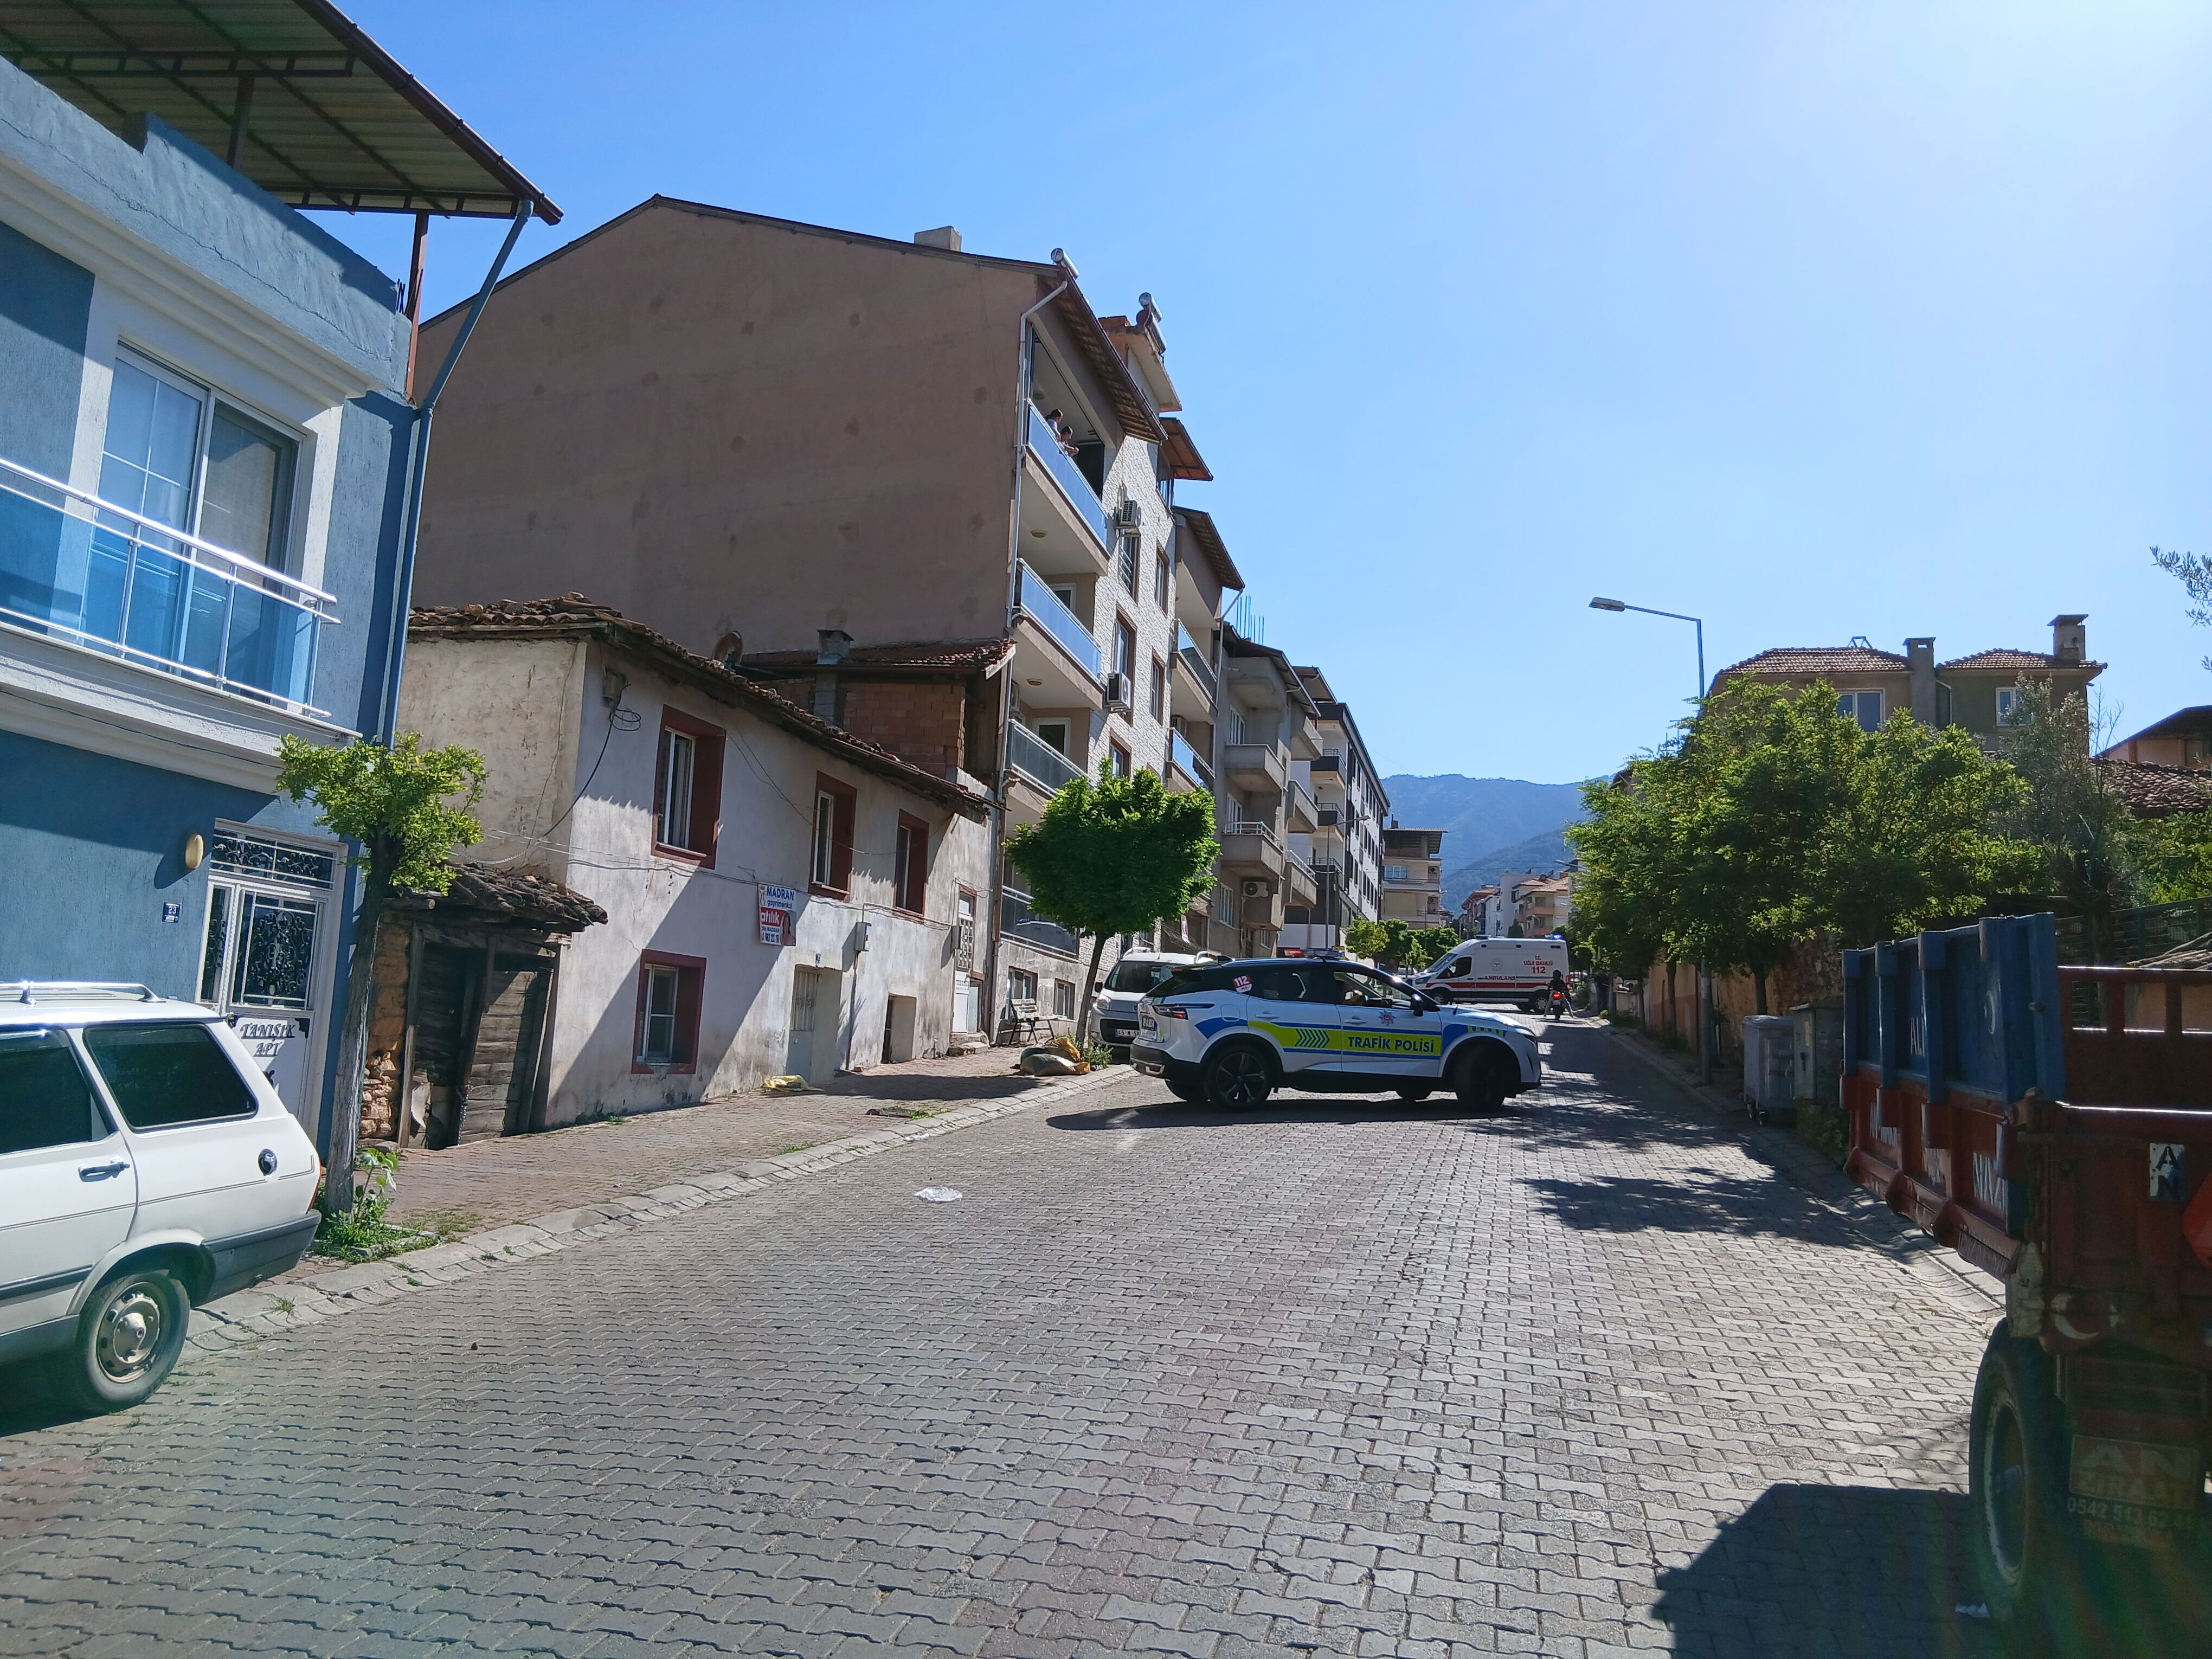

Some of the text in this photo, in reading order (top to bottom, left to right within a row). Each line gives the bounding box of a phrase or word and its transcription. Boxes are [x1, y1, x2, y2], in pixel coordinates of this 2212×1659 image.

[767, 886, 795, 901] MADRAN
[168, 905, 177, 914] 23
[761, 910, 780, 924] atılık
[1234, 975, 1249, 986] 112
[254, 1041, 282, 1057] APT
[1348, 1036, 1434, 1053] TRAFİK POLİSİ
[2067, 1496, 2108, 1519] 0542
[2112, 1504, 2143, 1525] 513
[2148, 1509, 2169, 1528] 62
